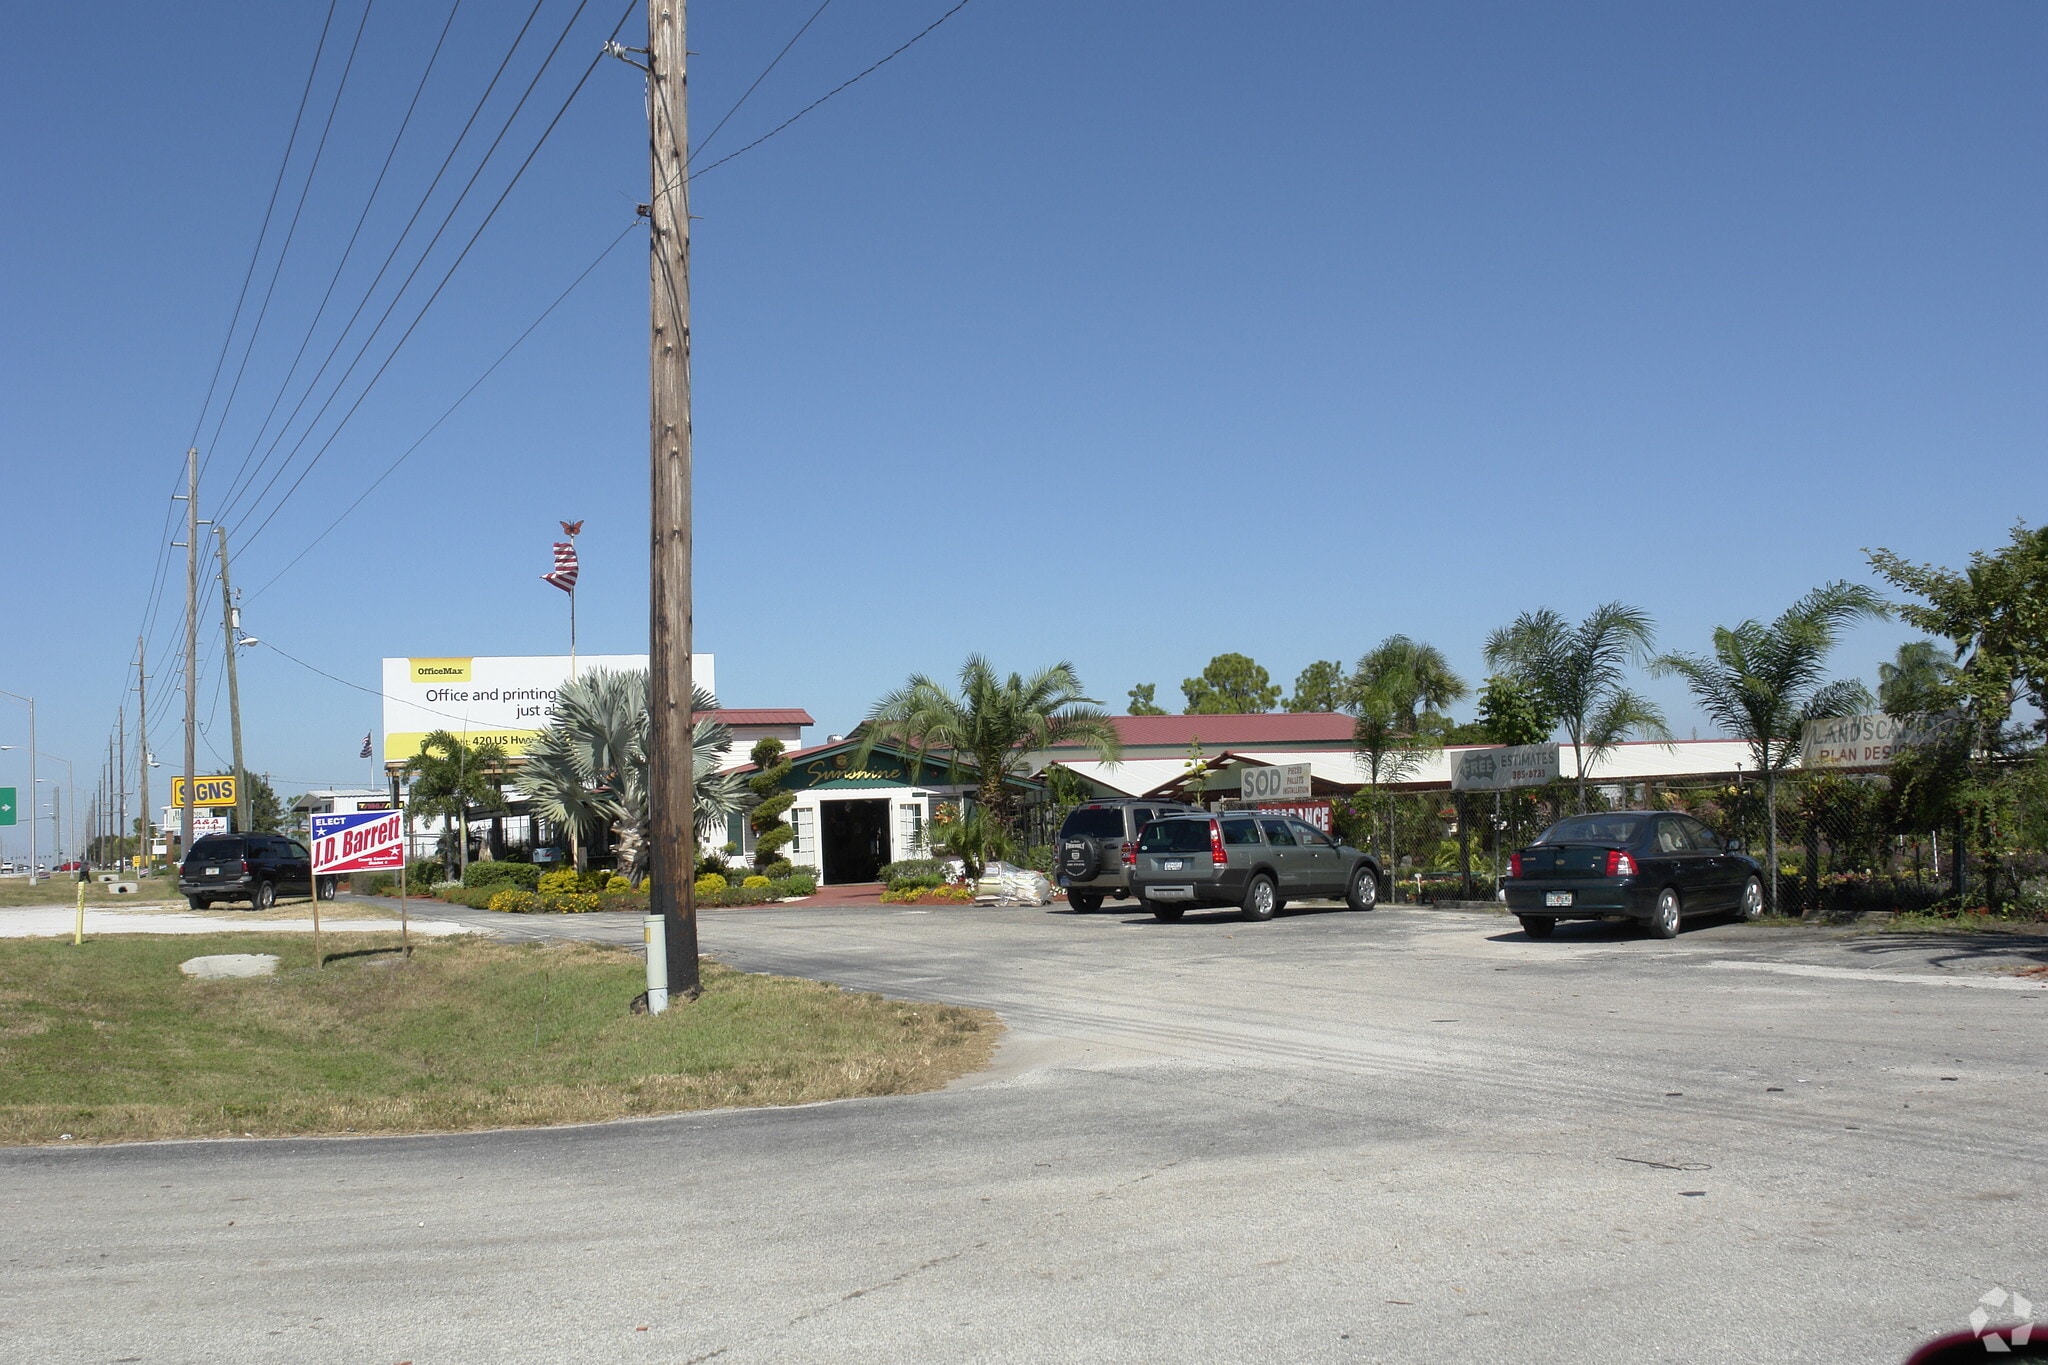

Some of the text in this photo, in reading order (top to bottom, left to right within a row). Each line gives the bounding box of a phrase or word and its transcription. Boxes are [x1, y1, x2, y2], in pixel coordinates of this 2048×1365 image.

[426, 687, 557, 703] Office and printing
[516, 704, 540, 719] just
[472, 736, 492, 747] 420
[495, 736, 508, 745] US
[1463, 751, 1555, 775] FREE ESTIMATES
[807, 760, 902, 787] Sunshine
[1286, 776, 1304, 785] PALLETS
[1243, 768, 1281, 798] SOD
[1282, 785, 1309, 795] INSTALLATION
[316, 817, 346, 826] ELECT
[313, 815, 401, 869] J.D. Barrett
